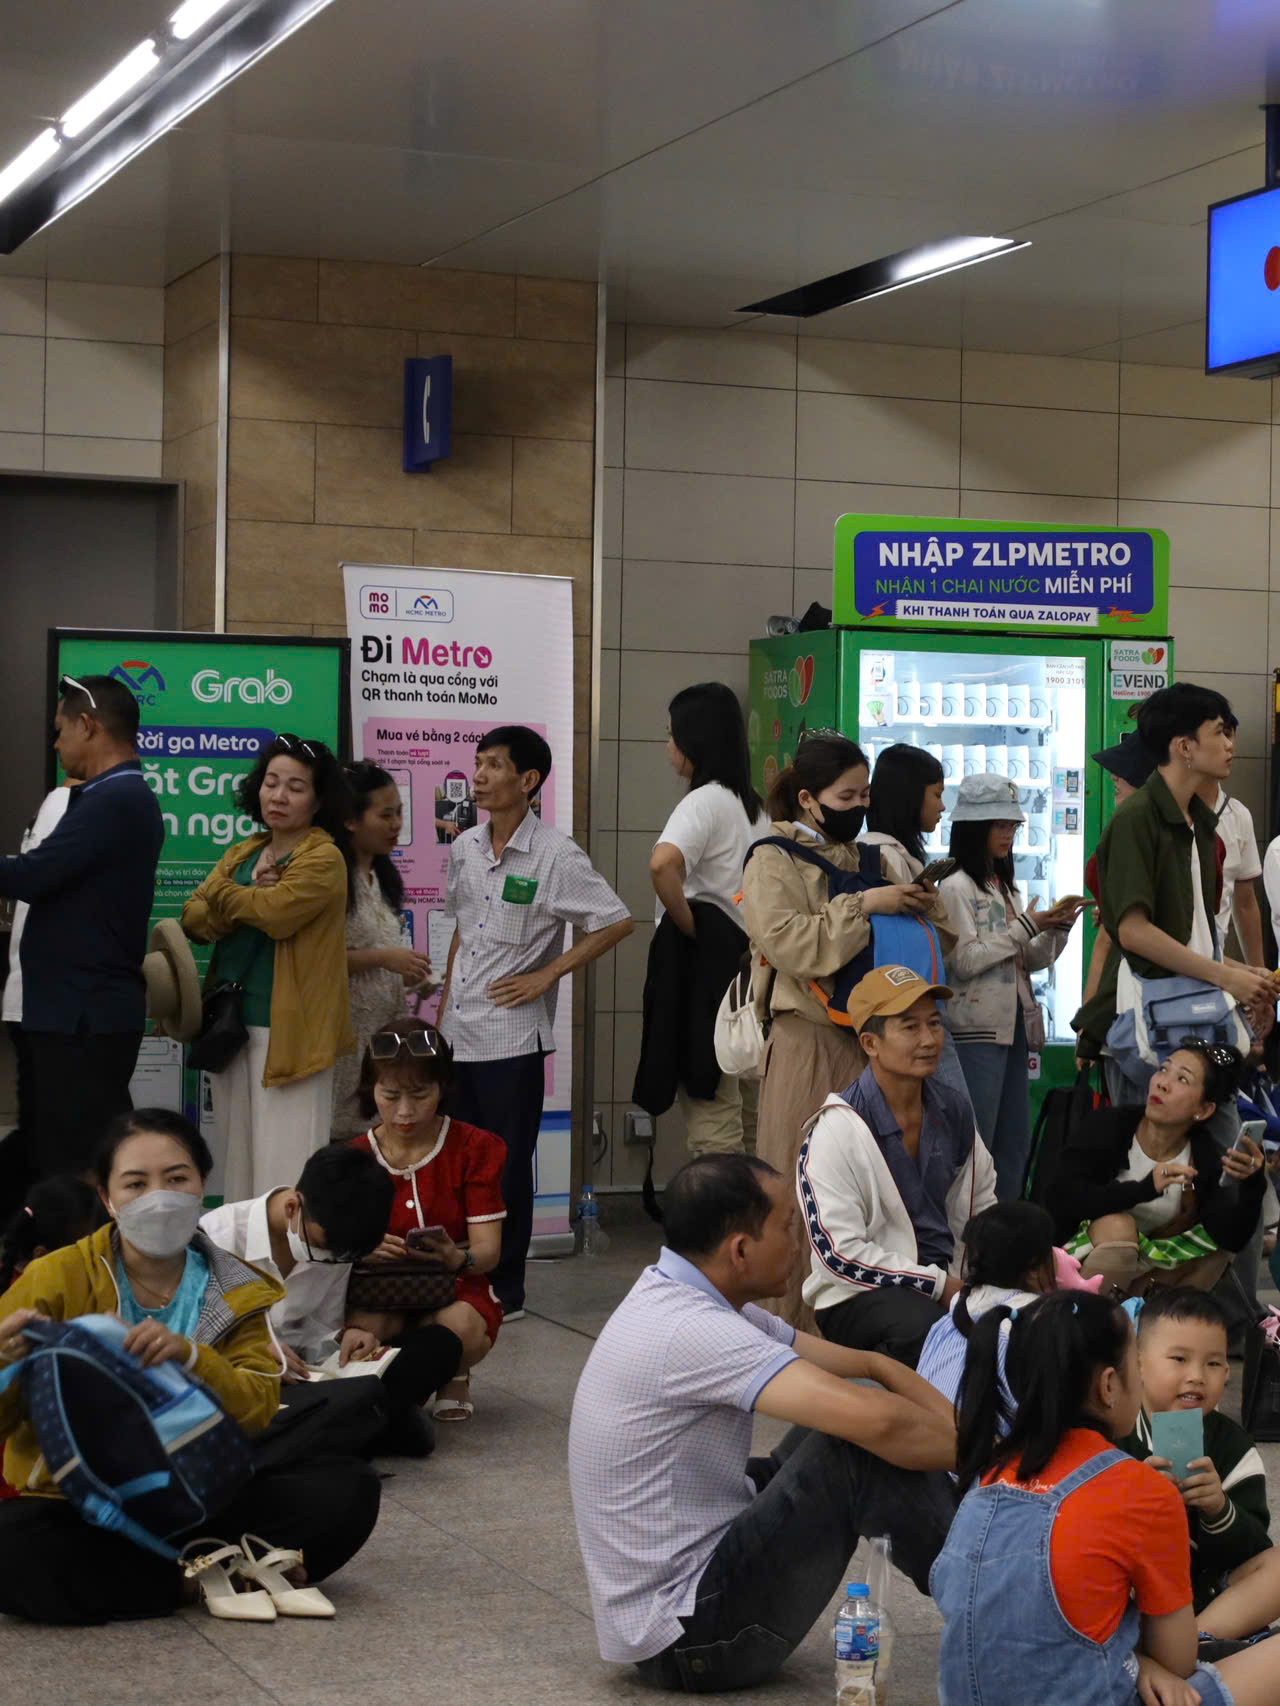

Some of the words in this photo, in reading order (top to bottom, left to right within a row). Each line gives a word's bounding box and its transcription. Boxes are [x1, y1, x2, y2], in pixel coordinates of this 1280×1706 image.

[878, 536, 964, 574] NHẬP
[972, 542, 1131, 567] ZLPMETRO
[875, 575, 927, 598] NHẬN
[930, 579, 936, 593] 1
[942, 578, 983, 594] CHAI
[989, 574, 1041, 594] NƯỚC
[1044, 570, 1096, 594] MIỄN
[1100, 573, 1132, 594] PHÍ
[903, 605, 924, 616] KHI
[927, 606, 970, 618] THANH
[973, 605, 1006, 619] TOÁN
[1009, 608, 1034, 621] QUA
[1038, 610, 1091, 622] ZALOPAY
[360, 634, 393, 664] Đi
[402, 636, 492, 669] Metro
[361, 669, 400, 687] Chạm
[404, 671, 417, 684] là
[420, 675, 445, 689] qua
[449, 670, 477, 689] cổng
[479, 675, 498, 688] với
[763, 669, 787, 684] SATRA
[1113, 674, 1165, 688] EVEND
[191, 669, 292, 705] Grab
[362, 688, 381, 701] QR
[384, 689, 423, 703] thanh
[427, 690, 455, 703] toán
[458, 691, 498, 705] MoMo
[763, 685, 787, 699] FOODS
[136, 731, 163, 749] Rời
[167, 736, 195, 754] ga
[200, 733, 260, 751] Metro
[377, 729, 403, 741] Mua
[405, 729, 420, 741] vé
[423, 728, 452, 744] bằng
[453, 732, 460, 742] 2
[187, 812, 268, 845] nga
